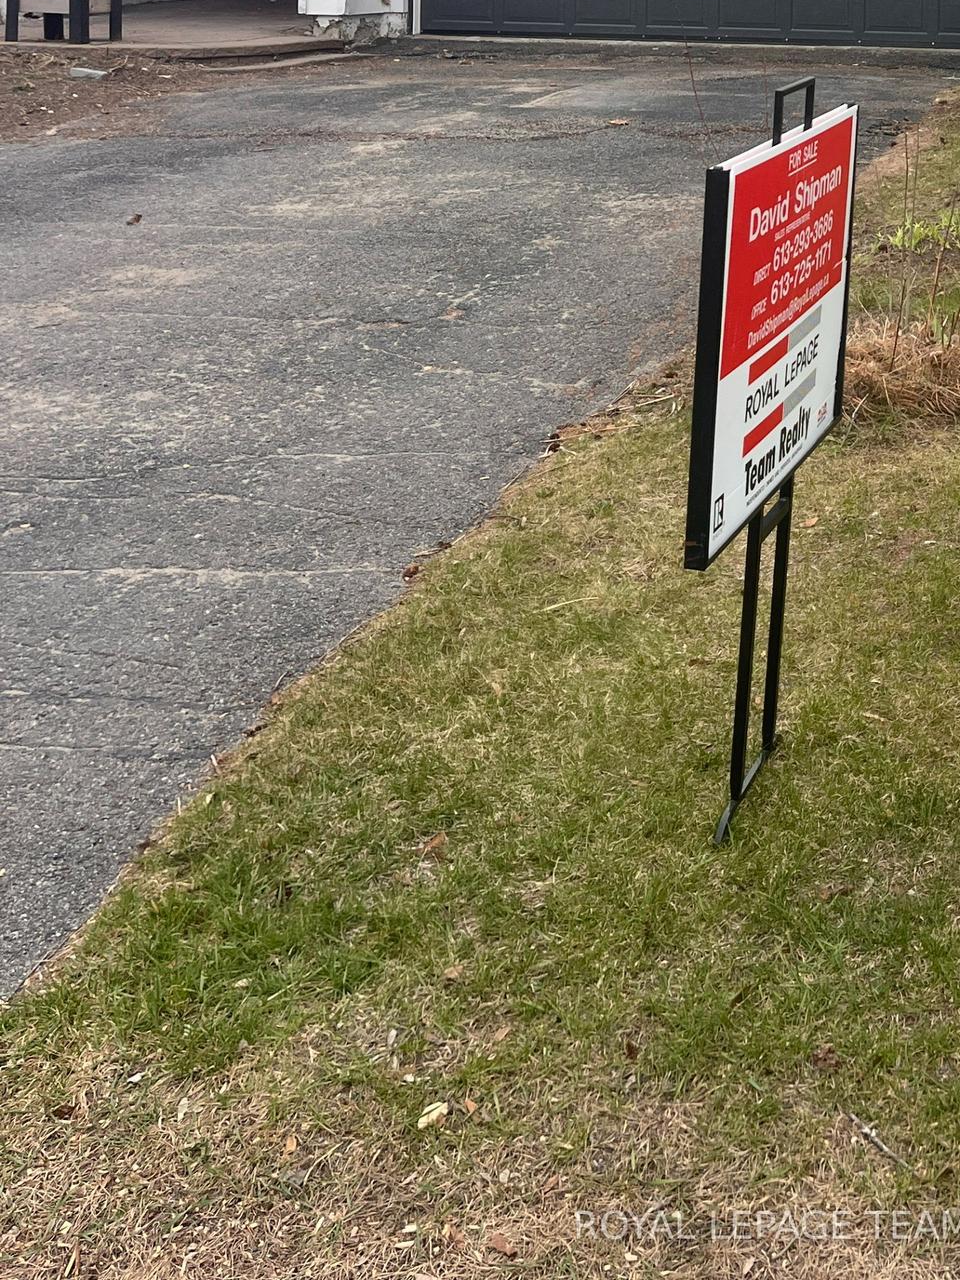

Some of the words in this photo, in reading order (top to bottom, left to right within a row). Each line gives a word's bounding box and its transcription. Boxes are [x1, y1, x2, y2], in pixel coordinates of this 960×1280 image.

[788, 149, 802, 171] FOR
[803, 140, 819, 162] SALE
[749, 190, 790, 242] David
[794, 165, 842, 214] Shipman
[751, 297, 768, 320] OFFICE
[770, 239, 832, 305] 613-725-1171
[753, 262, 772, 286] DIRECT
[773, 209, 834, 272] 613-293-3686
[744, 378, 780, 422] ROYAL
[745, 445, 776, 496] Team
[779, 406, 811, 463] Realty
